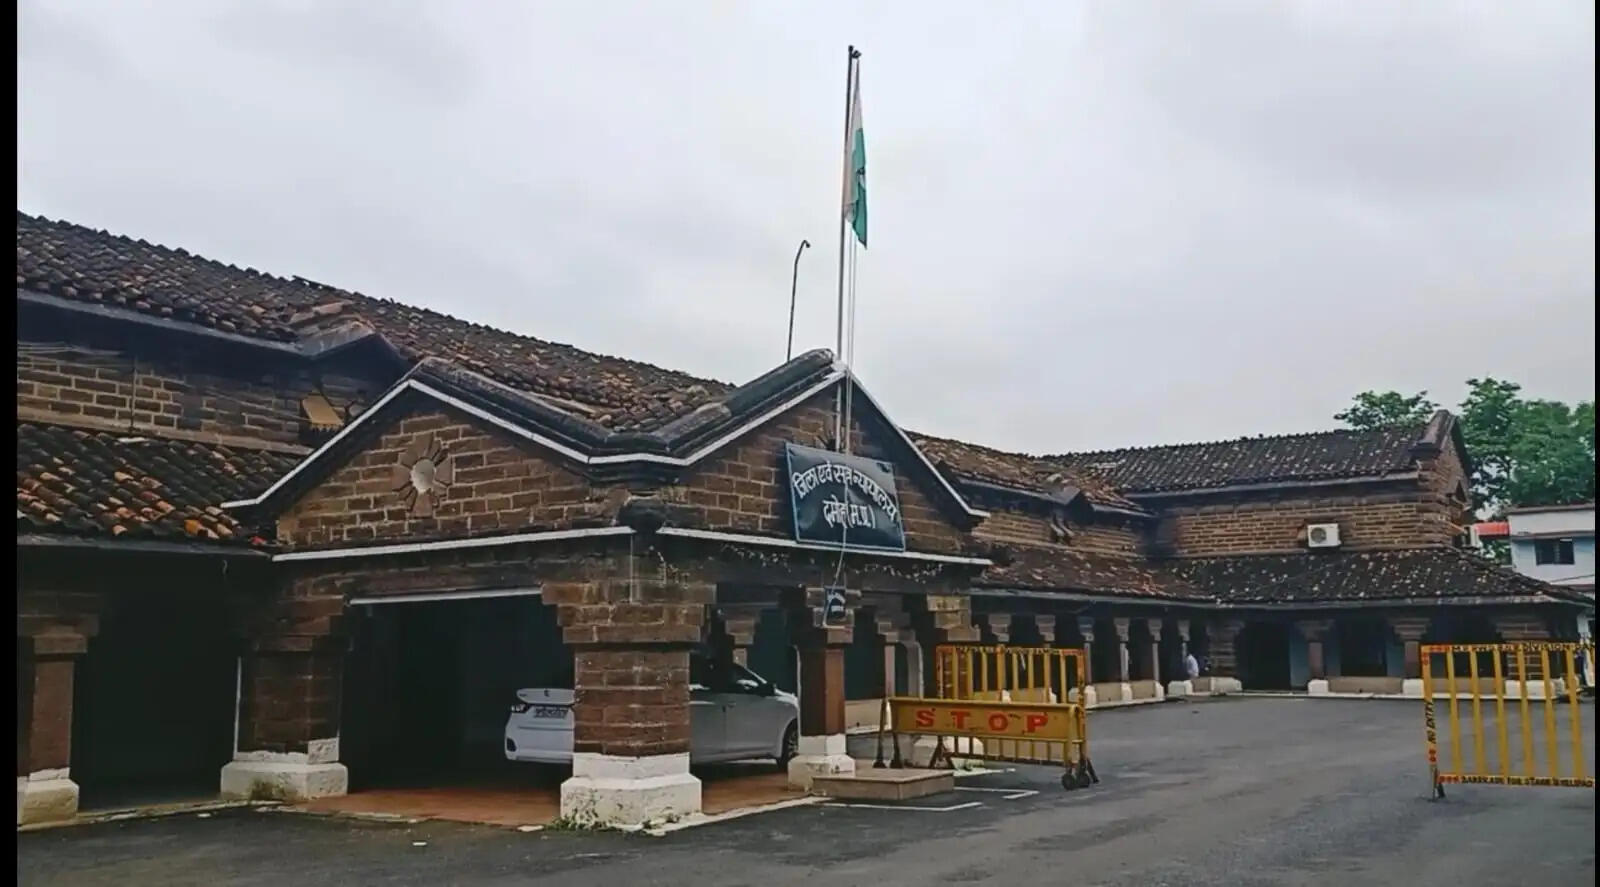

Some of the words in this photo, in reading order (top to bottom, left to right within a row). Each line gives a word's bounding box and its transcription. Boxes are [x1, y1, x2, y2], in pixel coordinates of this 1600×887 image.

[792, 467, 819, 499] जिला
[853, 469, 898, 522] न्यायालय
[915, 709, 1048, 733] STOP
